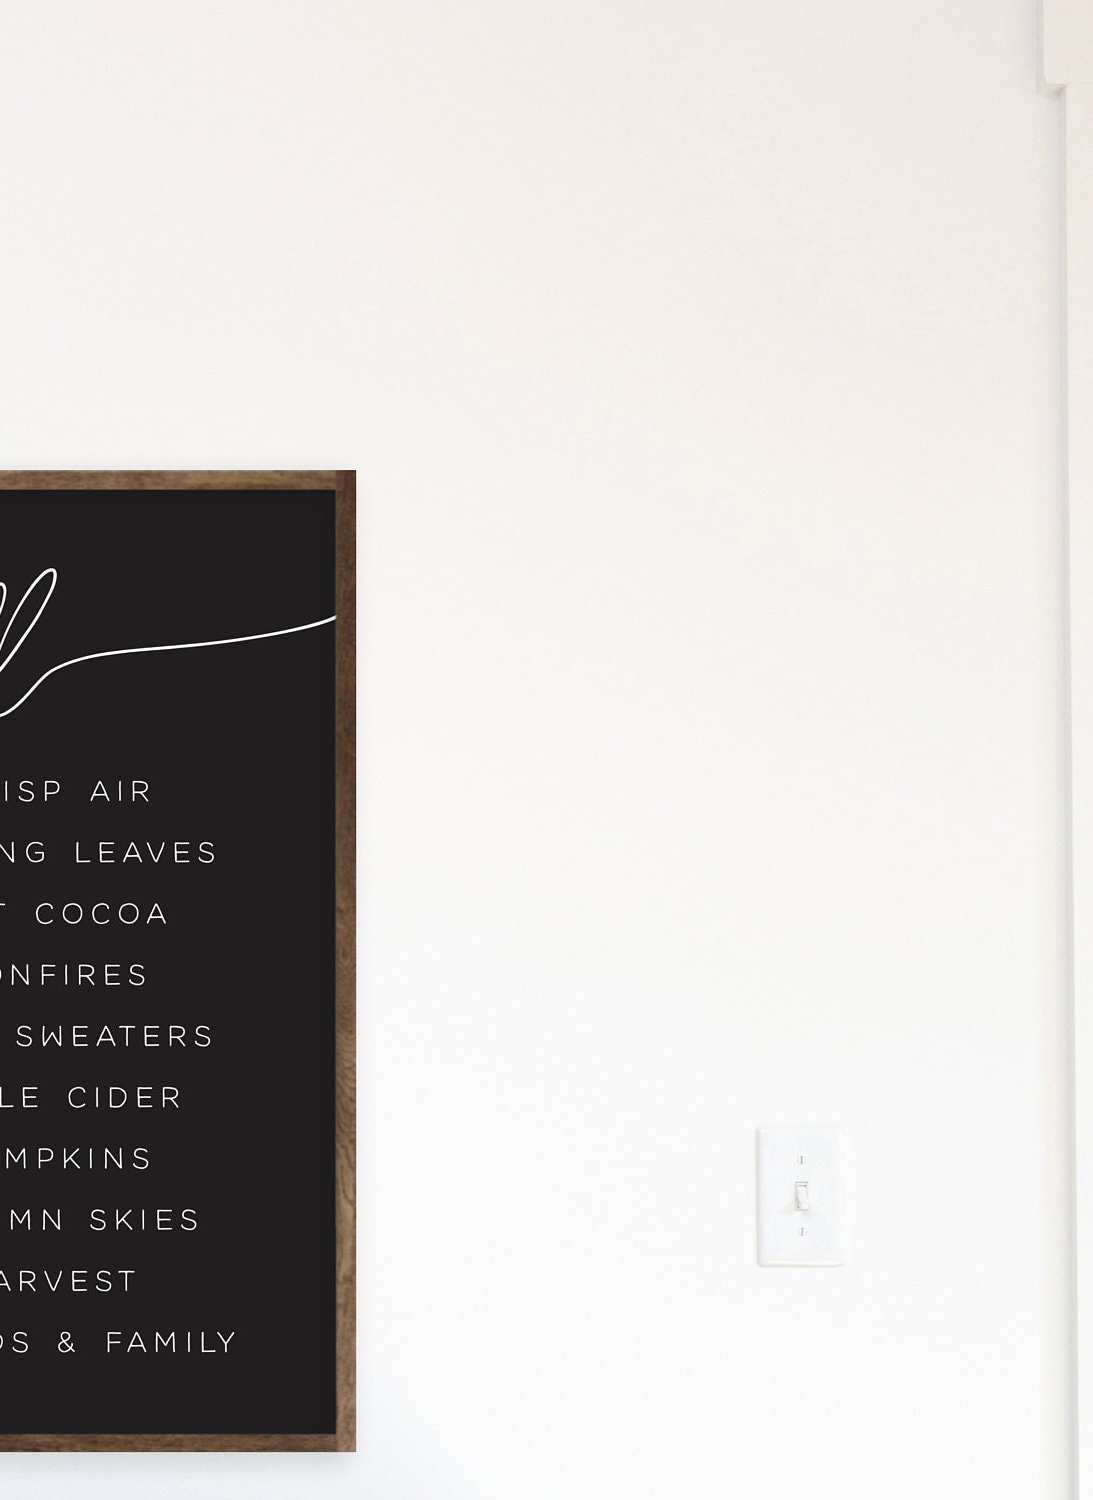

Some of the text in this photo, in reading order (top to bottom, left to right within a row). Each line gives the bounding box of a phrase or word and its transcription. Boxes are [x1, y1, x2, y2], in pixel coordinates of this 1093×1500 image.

[90, 780, 149, 802] AIR
[75, 841, 215, 864] LEAVES
[35, 902, 167, 925] COCOA
[16, 1025, 211, 1048] SWEATERS
[67, 1086, 179, 1109] CIDER
[89, 1208, 198, 1231] SKIES
[57, 1331, 76, 1354] &
[106, 1331, 235, 1354] FAMILY
